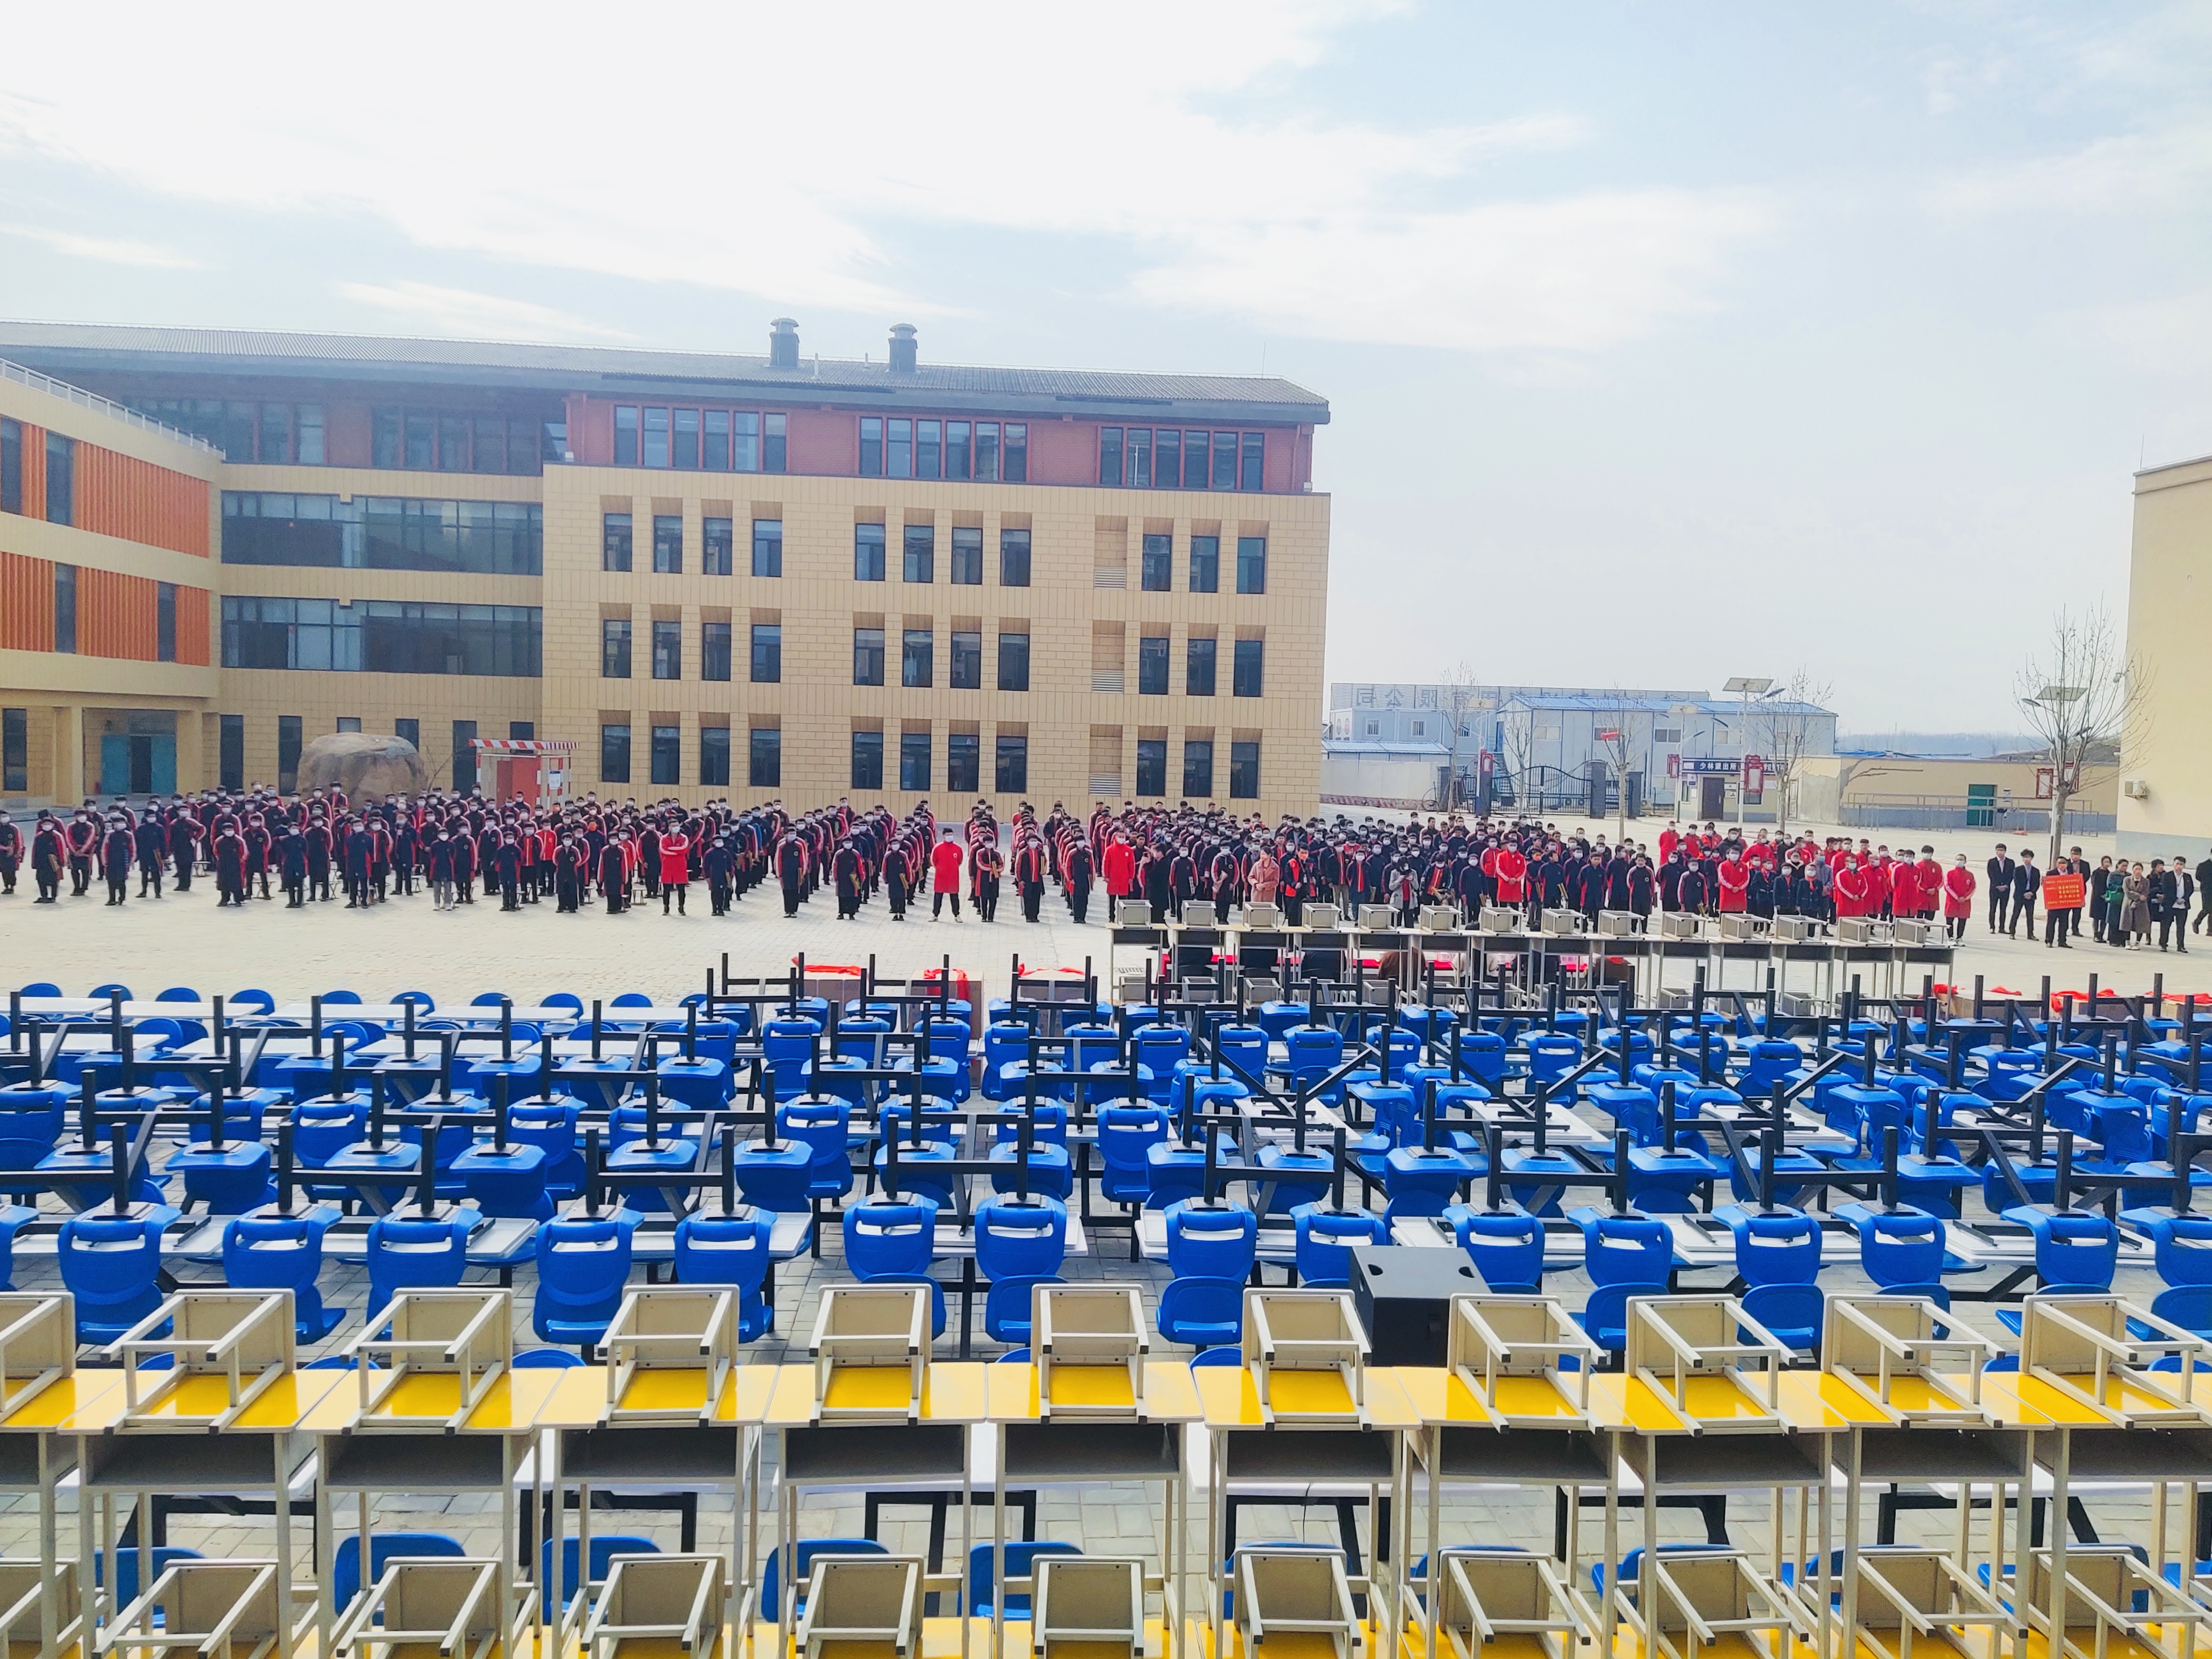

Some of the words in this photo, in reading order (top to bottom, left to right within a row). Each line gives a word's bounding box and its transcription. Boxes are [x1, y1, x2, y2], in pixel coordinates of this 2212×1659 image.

[1699, 762, 1737, 771] 少林派出所
